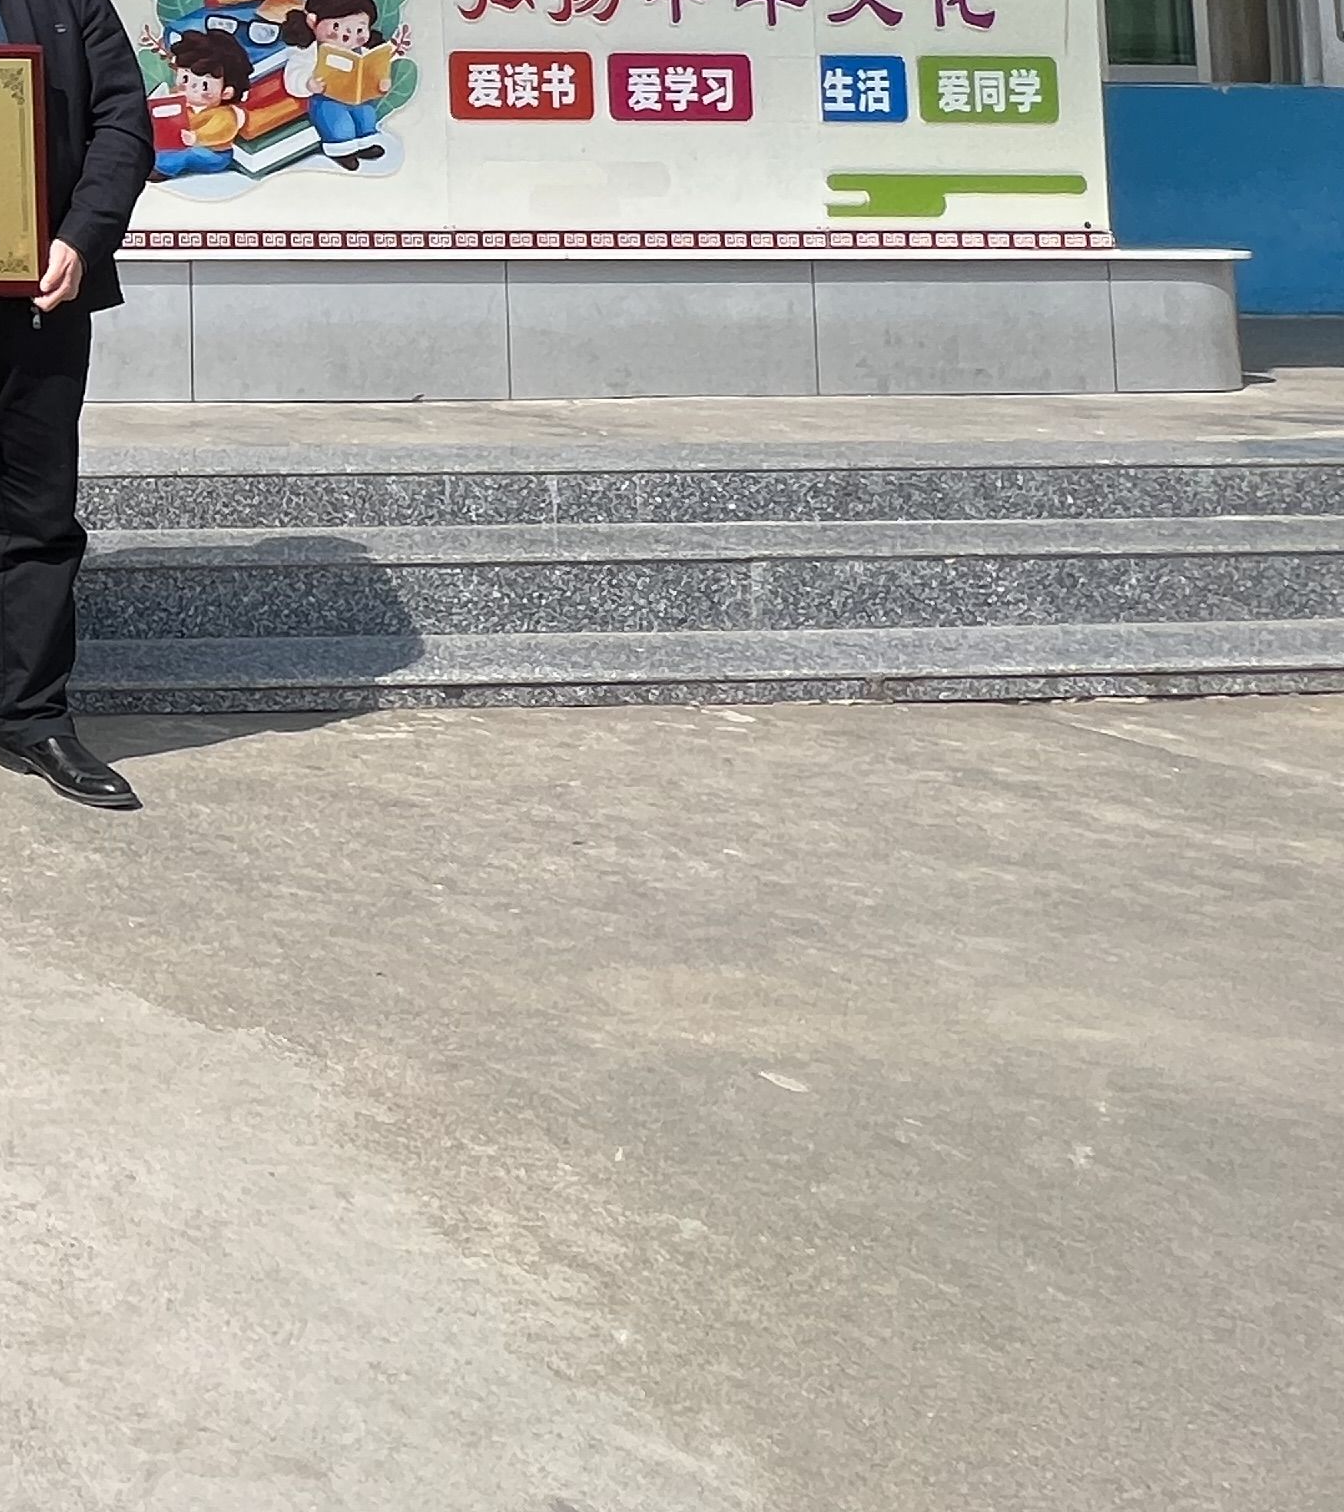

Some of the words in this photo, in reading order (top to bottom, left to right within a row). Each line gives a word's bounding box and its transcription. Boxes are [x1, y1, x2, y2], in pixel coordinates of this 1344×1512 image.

[467, 64, 577, 109] 爱读书
[627, 67, 736, 112] 爱学习
[822, 69, 890, 113] 生活
[937, 70, 1043, 114] 爱同学
